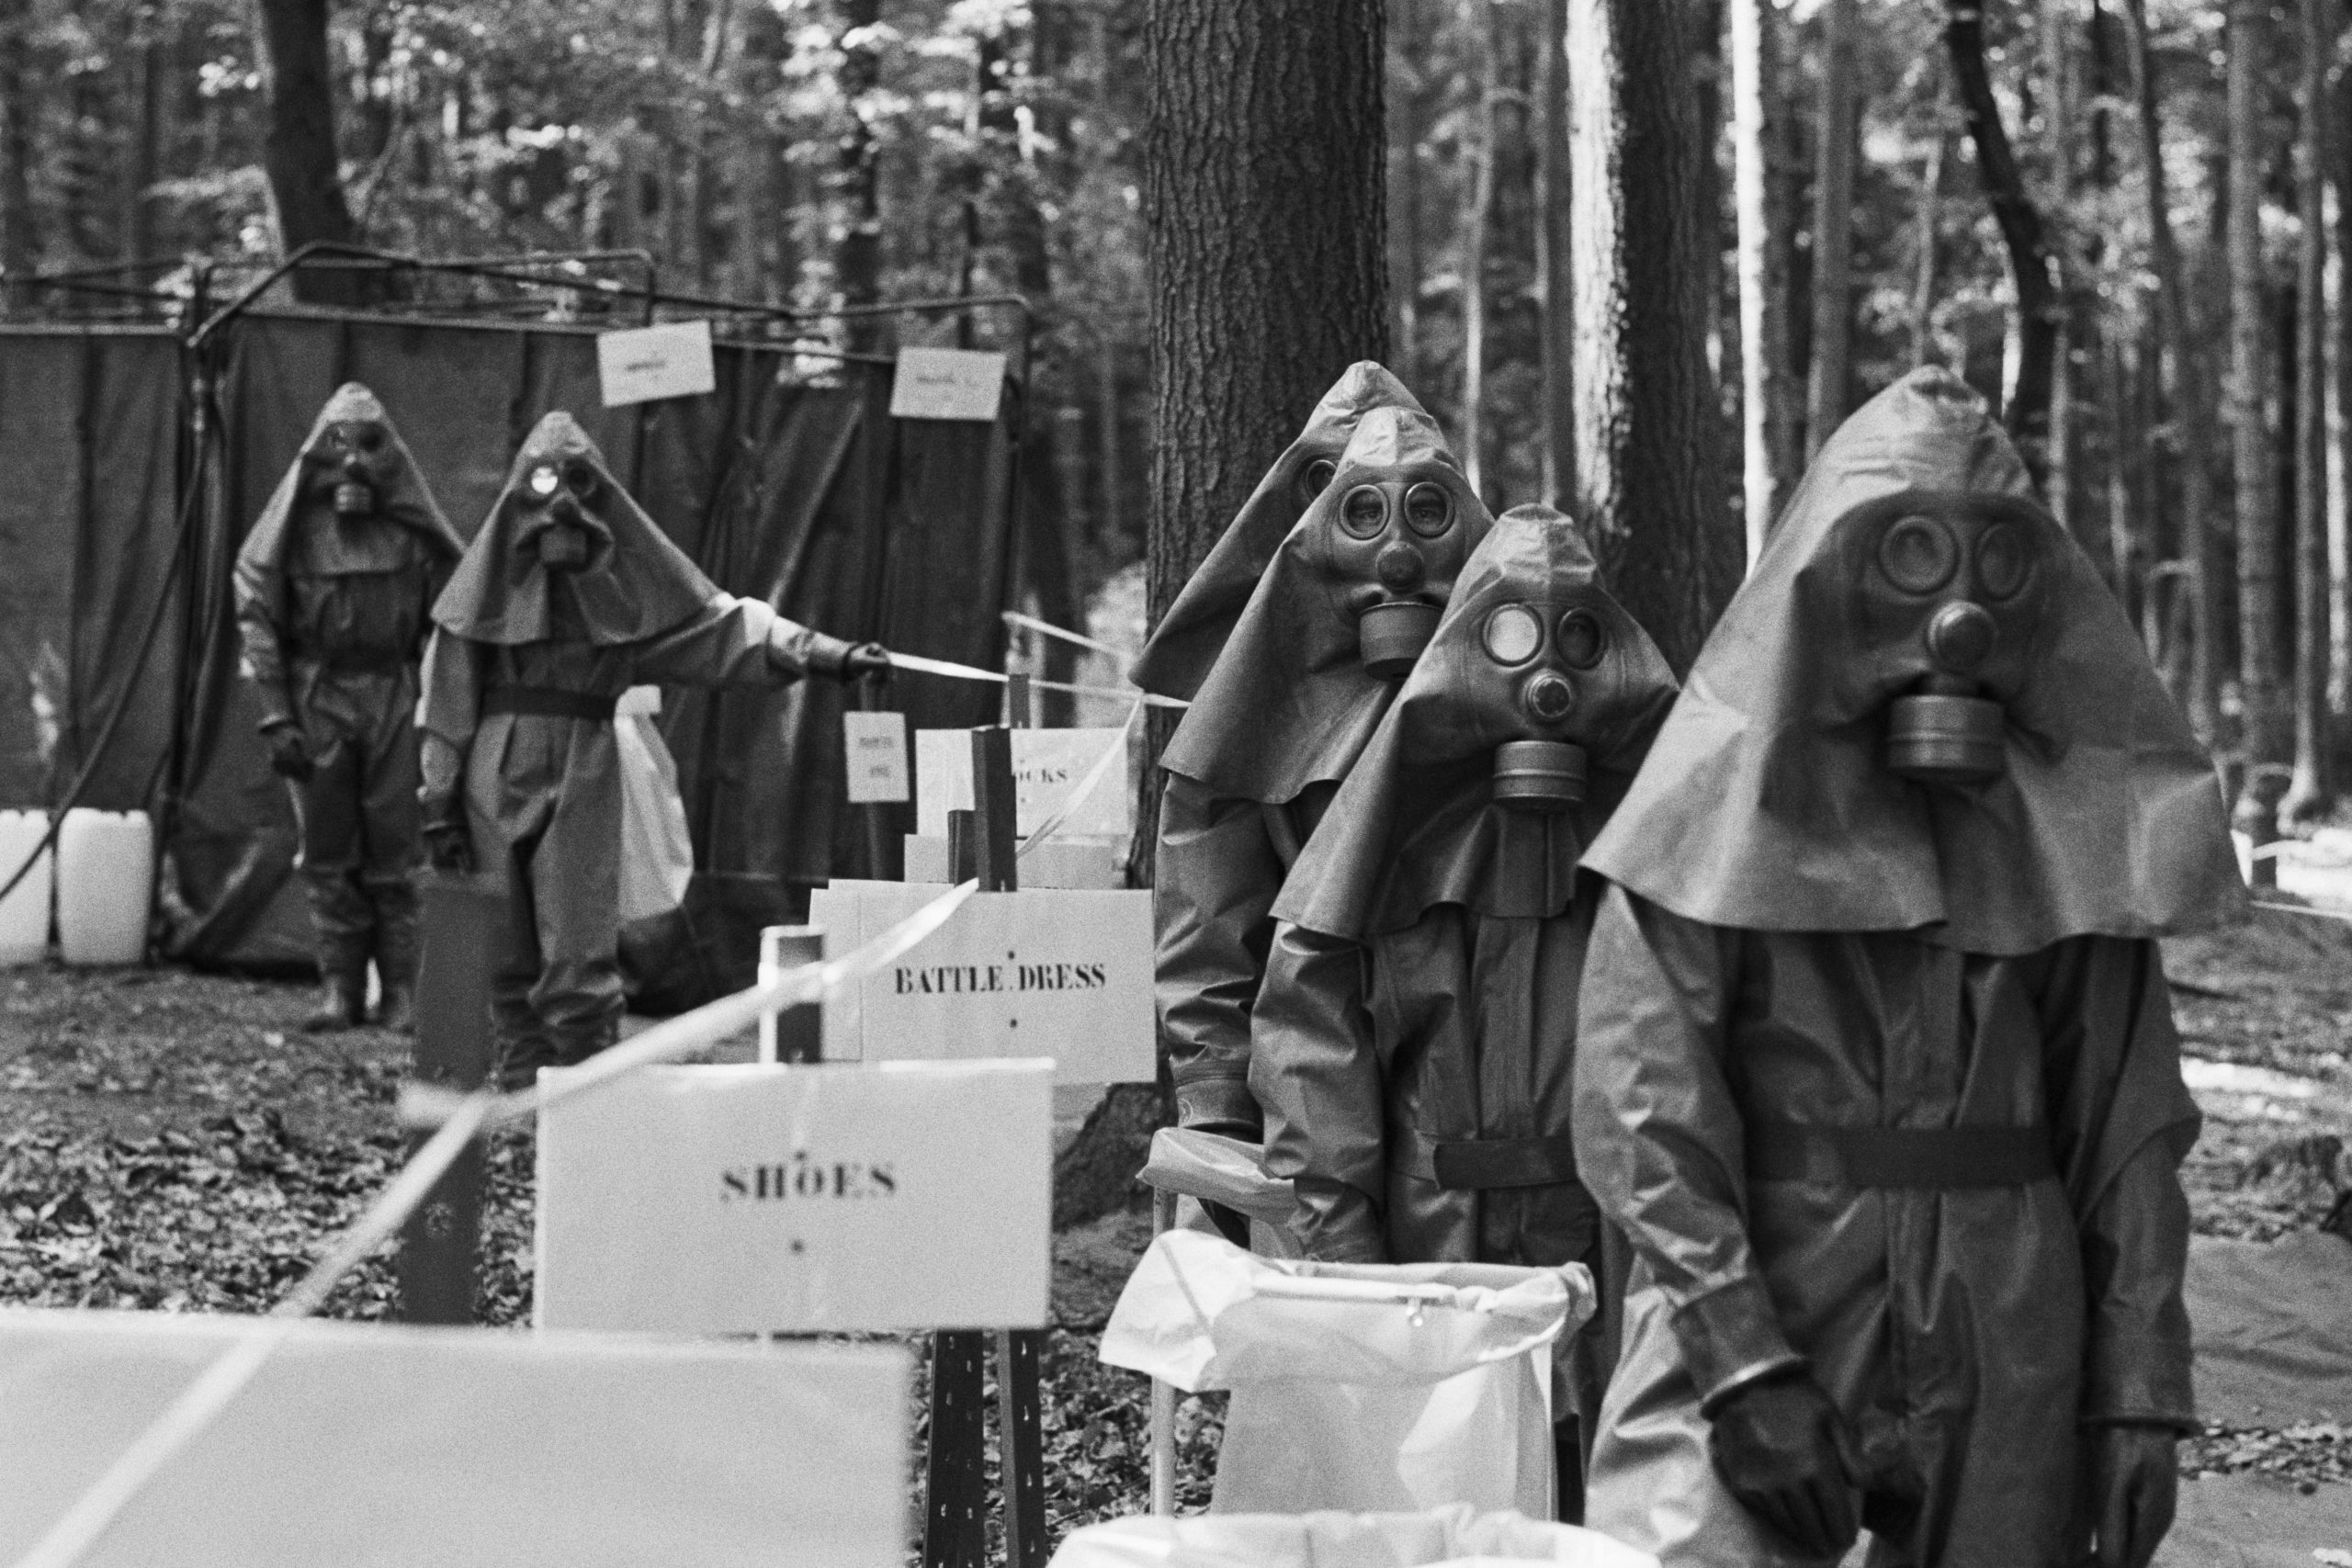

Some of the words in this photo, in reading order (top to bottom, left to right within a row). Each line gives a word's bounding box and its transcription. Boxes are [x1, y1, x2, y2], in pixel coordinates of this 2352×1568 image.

[1014, 769, 1067, 783] OCKS
[896, 965, 1003, 995] BATTLE
[1018, 963, 1105, 991] DRESS
[721, 1162, 896, 1201] SHOES
